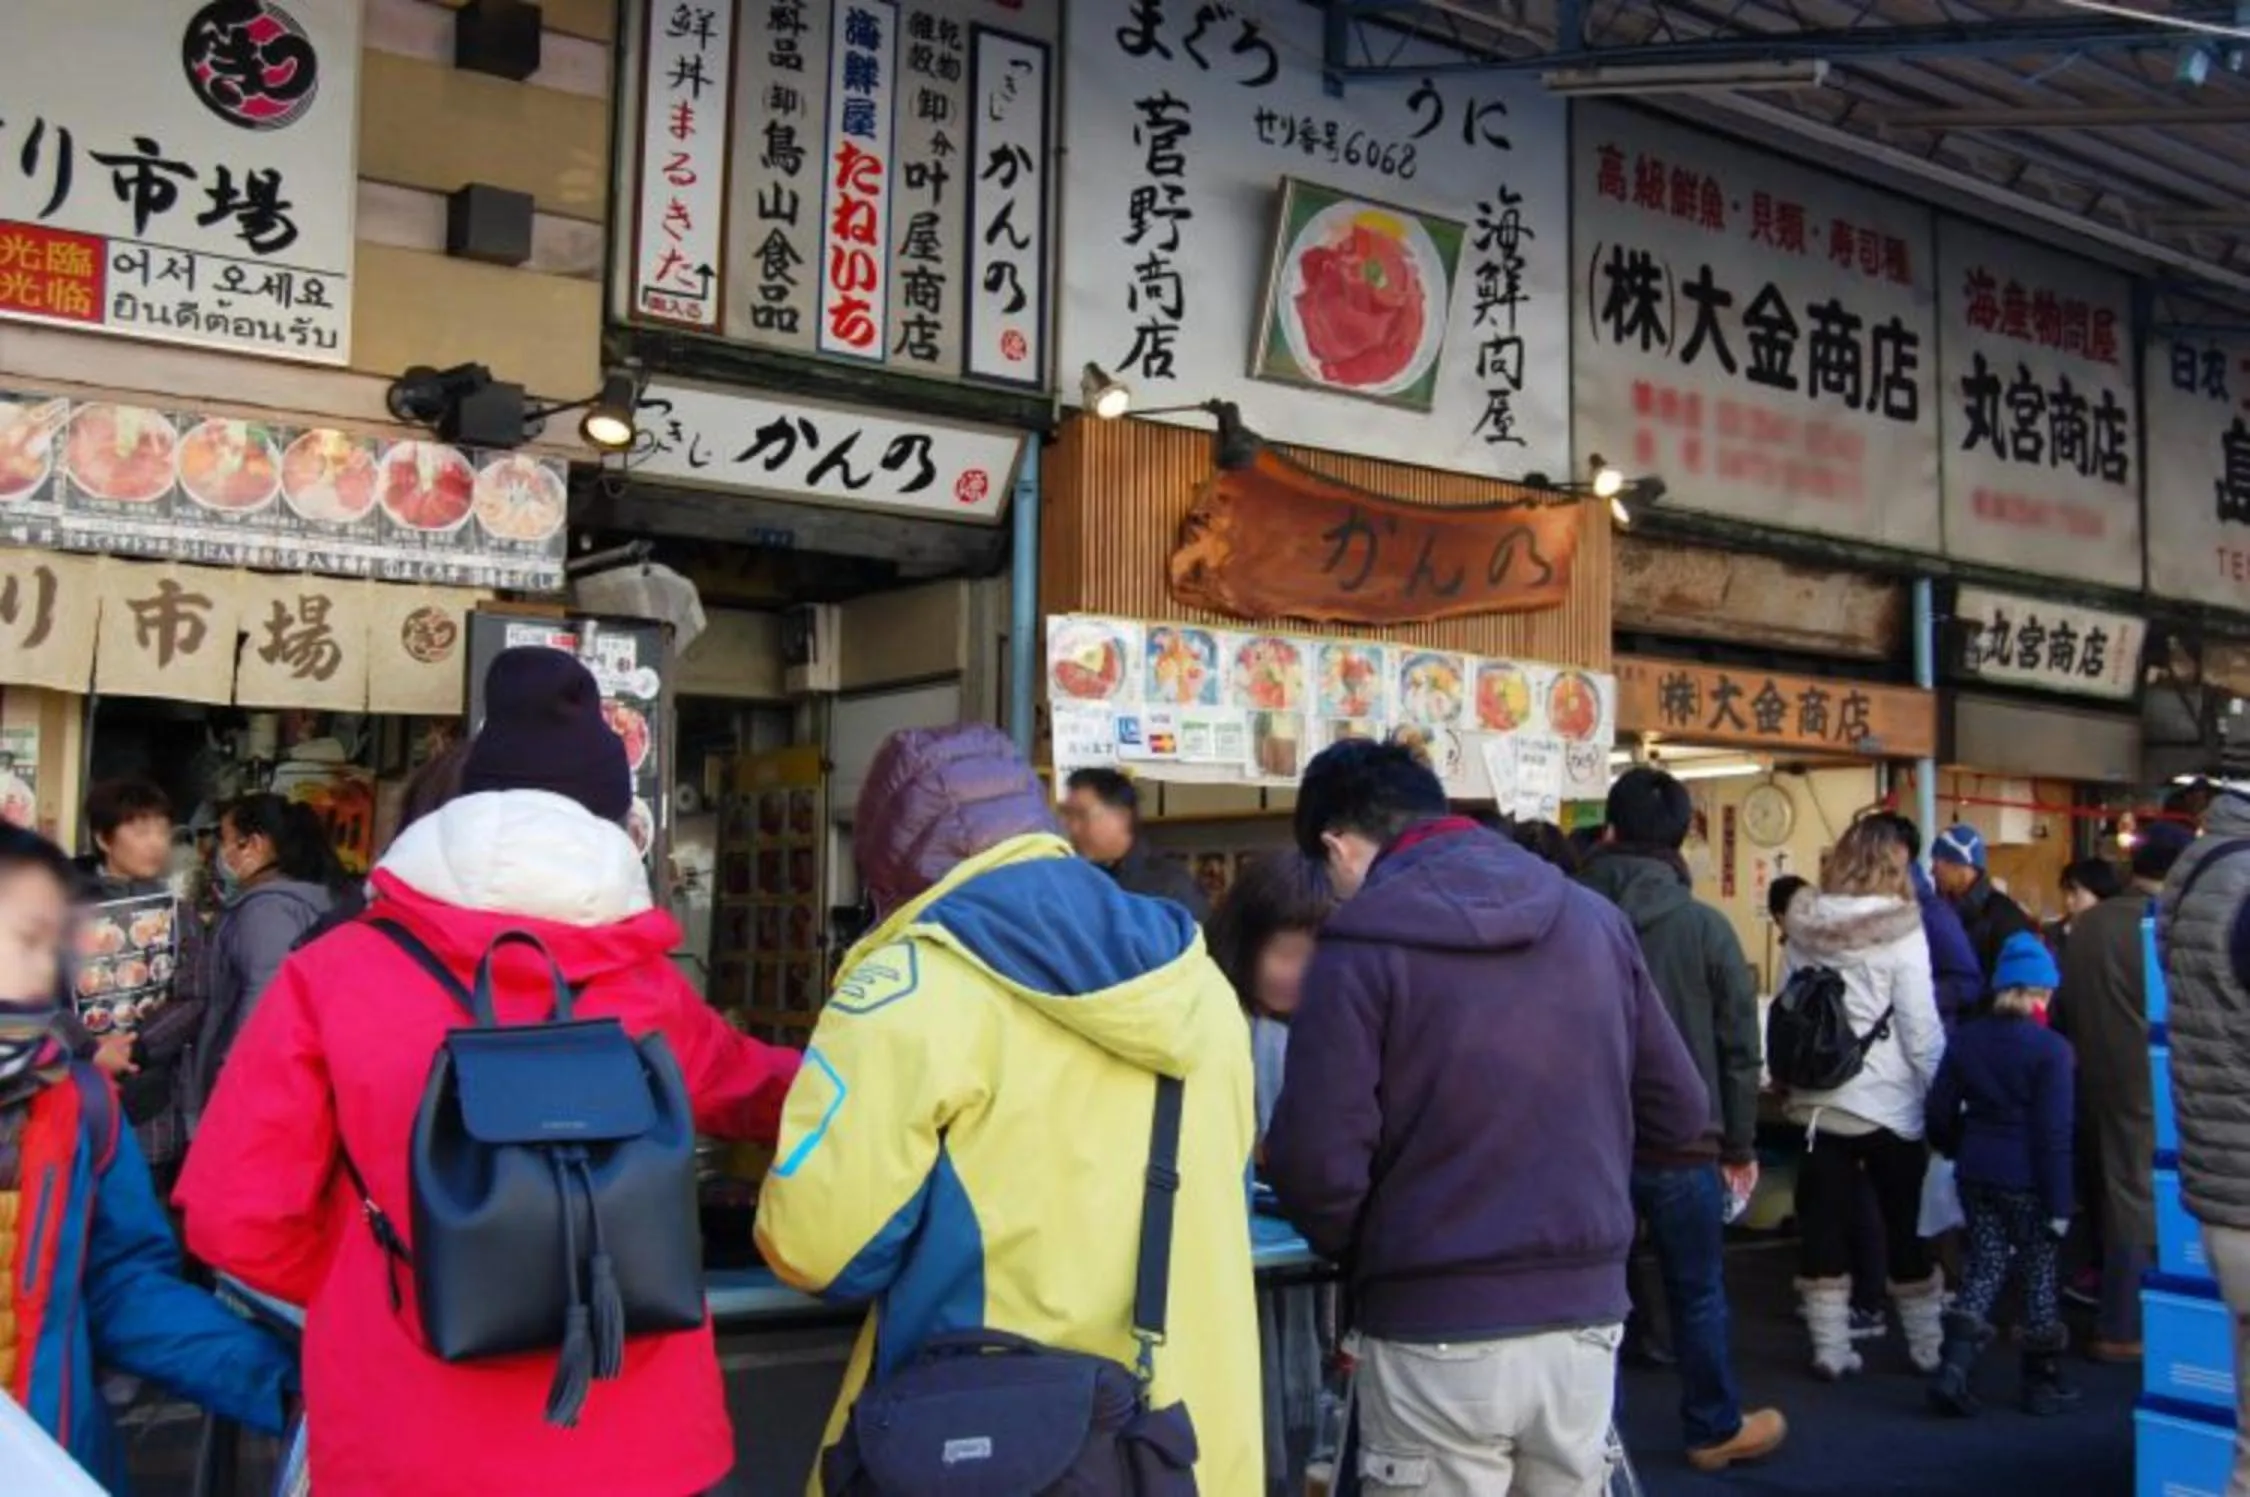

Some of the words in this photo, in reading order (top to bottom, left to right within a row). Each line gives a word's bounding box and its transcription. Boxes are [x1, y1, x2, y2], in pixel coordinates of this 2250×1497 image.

[1116, 0, 1279, 88] まぐろ
[1407, 77, 1513, 151] うに
[0, 116, 300, 256] り市場
[113, 249, 196, 291] 어서
[213, 265, 333, 308] 오세요
[828, 140, 883, 348] たねいち
[1117, 89, 1193, 381] 菅野商店
[734, 415, 937, 493] かんの
[1960, 350, 2129, 486] 丸宮商店
[1320, 507, 1554, 597] かんの
[2216, 546, 2250, 581] TE
